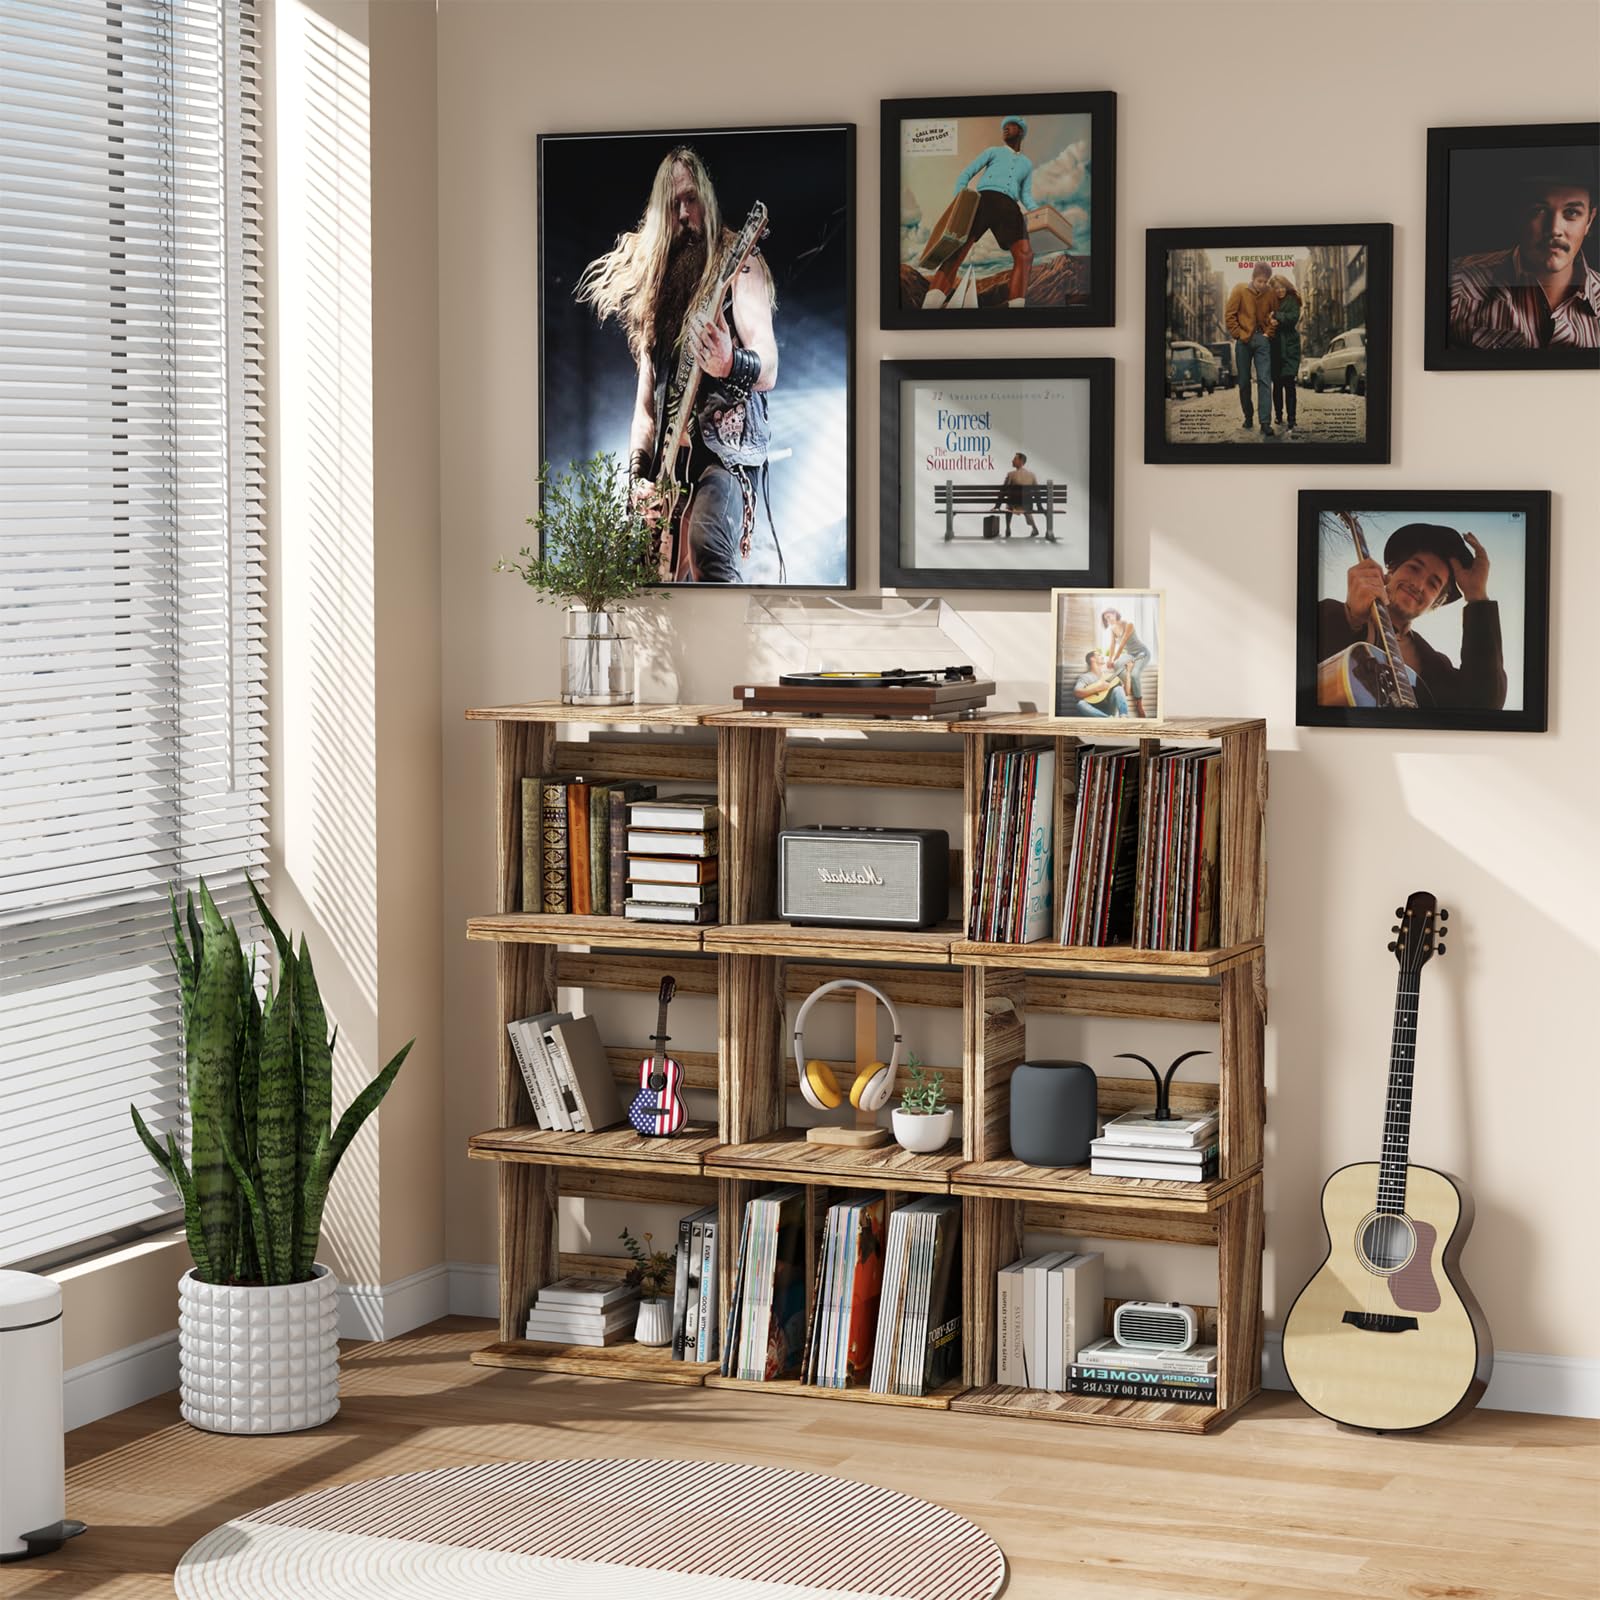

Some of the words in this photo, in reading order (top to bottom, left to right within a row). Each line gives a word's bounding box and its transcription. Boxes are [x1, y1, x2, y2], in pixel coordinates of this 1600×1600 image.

[935, 131, 949, 140] LOST
[1240, 254, 1294, 262] FREEWHEELIN'
[937, 409, 992, 430] Forrest
[934, 446, 947, 457] The
[946, 431, 991, 456] Gump
[926, 455, 995, 471] Soundtrack
[511, 1032, 528, 1073] FRANKFURT
[525, 1074, 535, 1094] NEUE
[531, 1095, 541, 1111] DAS
[685, 1335, 695, 1349] 32
